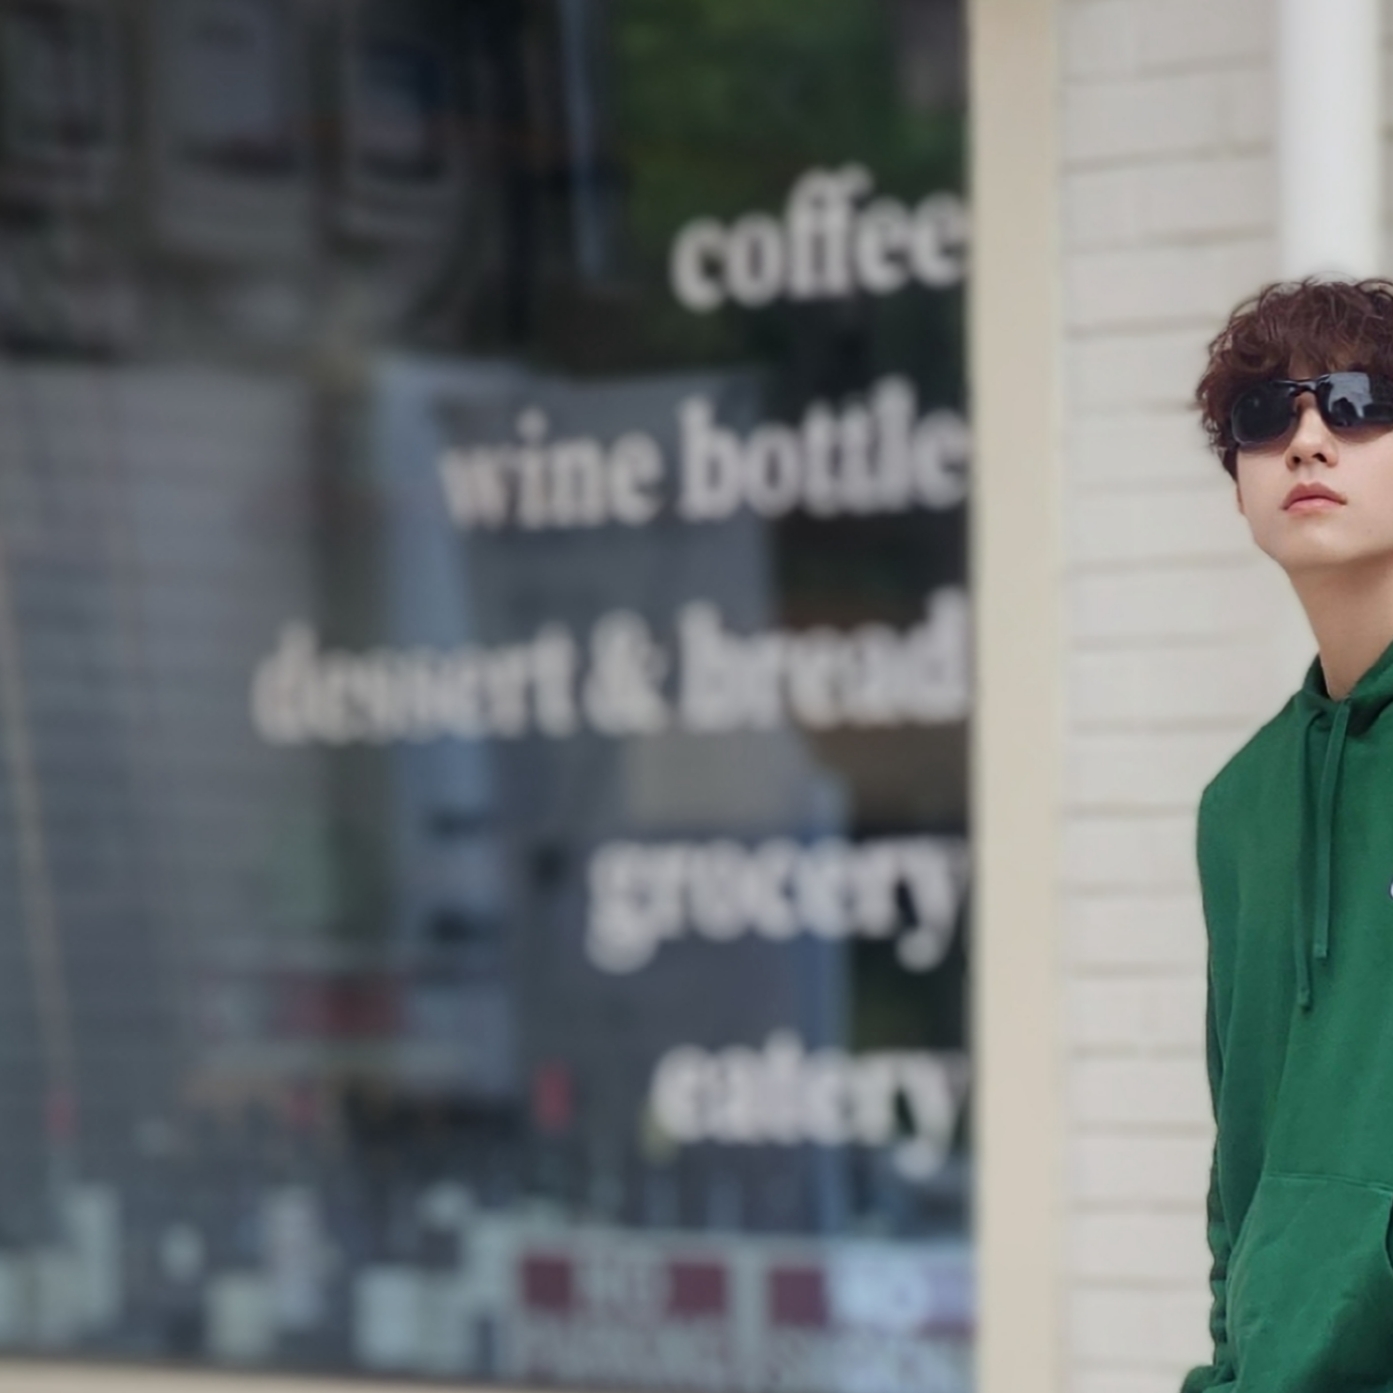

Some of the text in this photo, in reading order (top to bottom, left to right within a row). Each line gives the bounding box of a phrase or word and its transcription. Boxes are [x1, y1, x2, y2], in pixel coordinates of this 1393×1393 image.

[671, 165, 969, 310] coffee
[441, 376, 969, 530] wine bottle
[250, 588, 969, 745] dessert & bread
[586, 836, 967, 972] grocery
[650, 1031, 967, 1179] eatery
